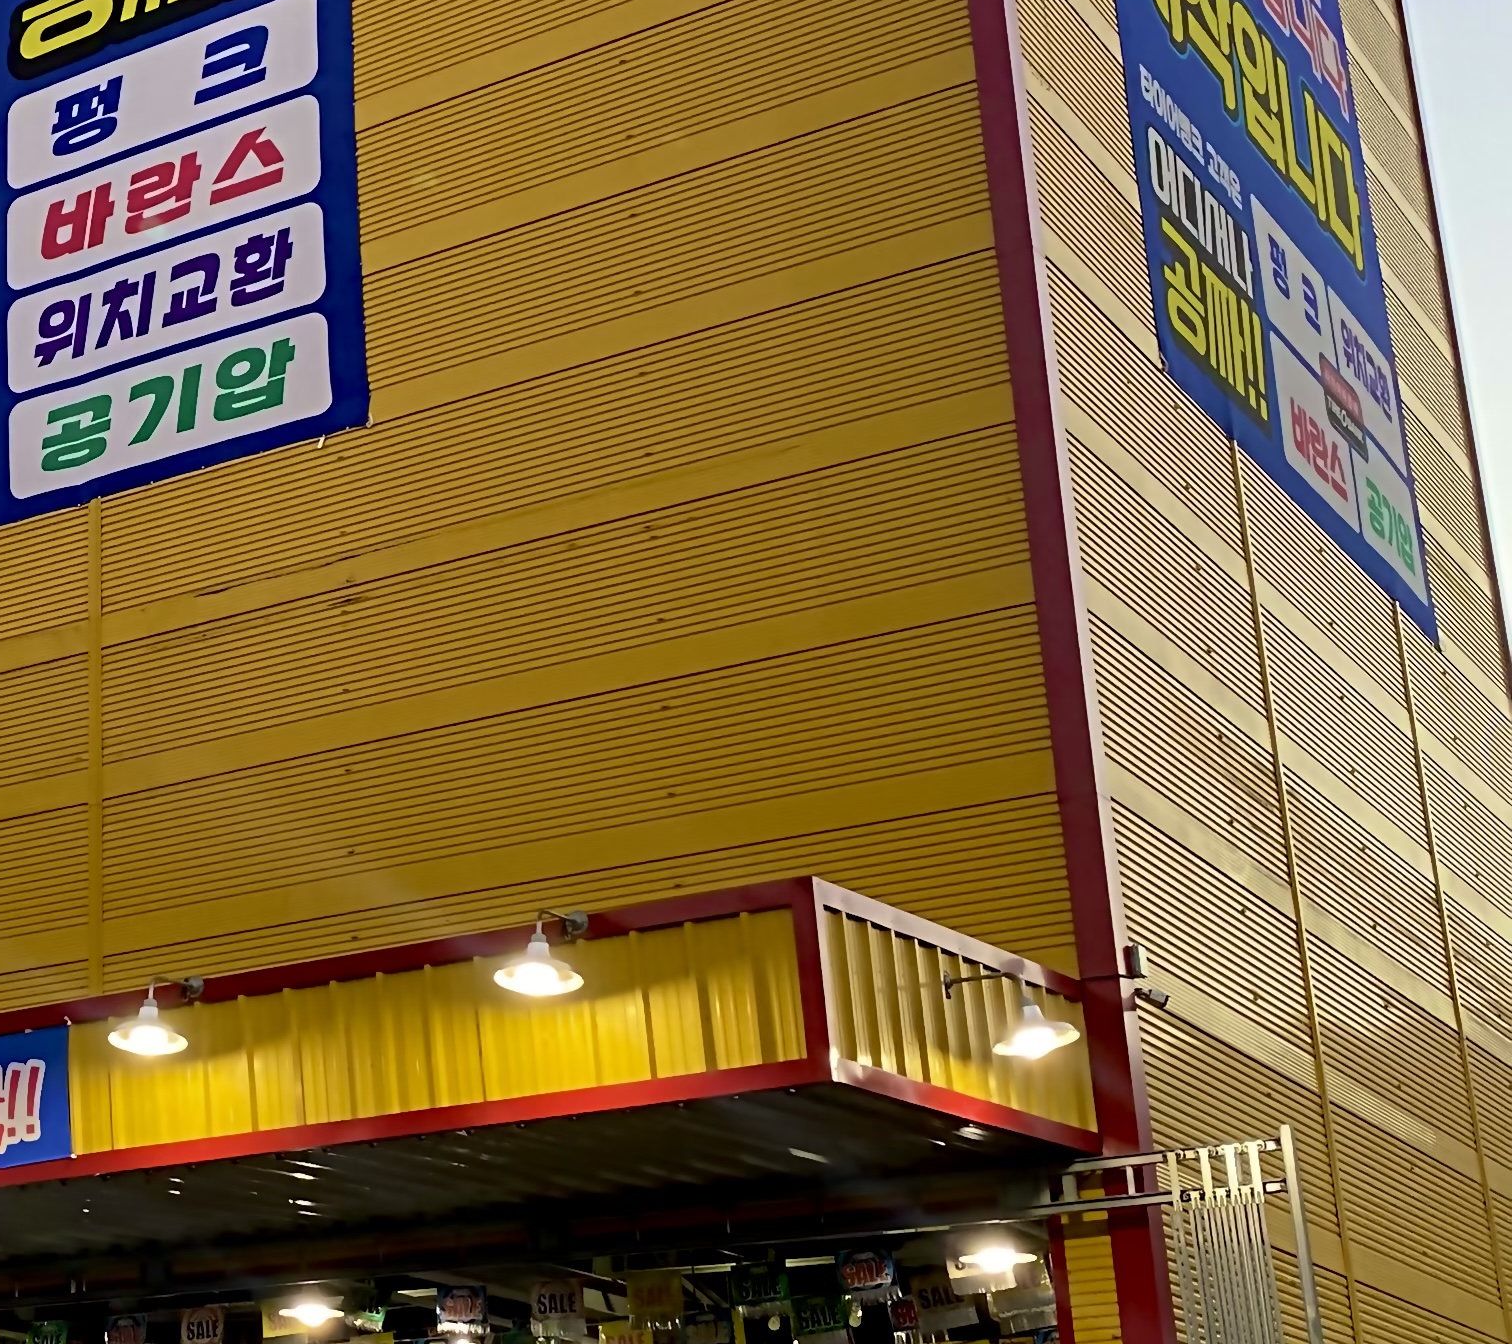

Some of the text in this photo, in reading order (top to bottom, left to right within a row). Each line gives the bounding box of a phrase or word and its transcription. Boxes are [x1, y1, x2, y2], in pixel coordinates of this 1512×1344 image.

[1139, 63, 1205, 167] 타이어뱅크
[40, 126, 285, 260] 바란스
[34, 226, 294, 368] 위치교환
[40, 337, 296, 472] 공기압
[1340, 318, 1393, 424] 위치교환
[1289, 395, 1348, 503] 바란스
[1364, 475, 1416, 577] 공기압
[187, 1319, 219, 1341] SALE
[538, 1293, 577, 1315] SALE
